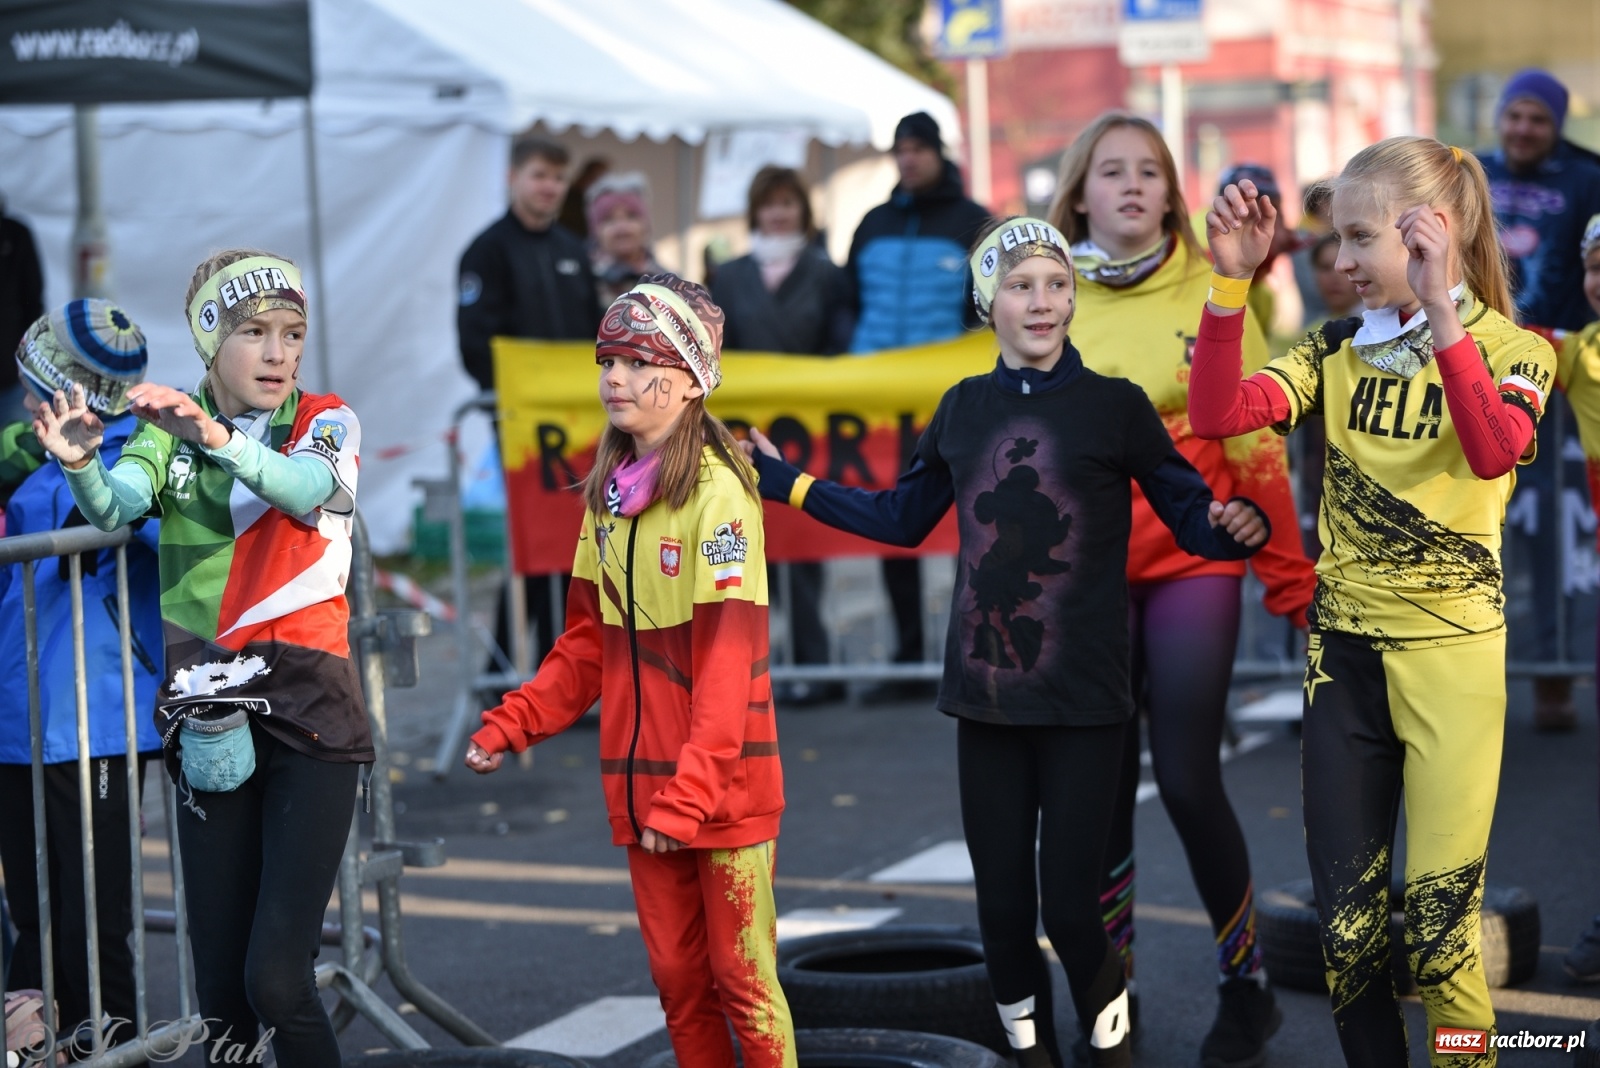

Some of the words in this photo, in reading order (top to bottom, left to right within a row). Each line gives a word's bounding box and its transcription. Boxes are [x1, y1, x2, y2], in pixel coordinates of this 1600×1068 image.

[1000, 223, 1061, 252] ELITA
[219, 267, 290, 310] ELITA
[642, 376, 673, 409] 19
[1509, 361, 1550, 392] HELA
[1347, 376, 1443, 440] HELA
[308, 442, 340, 464] ALETY
